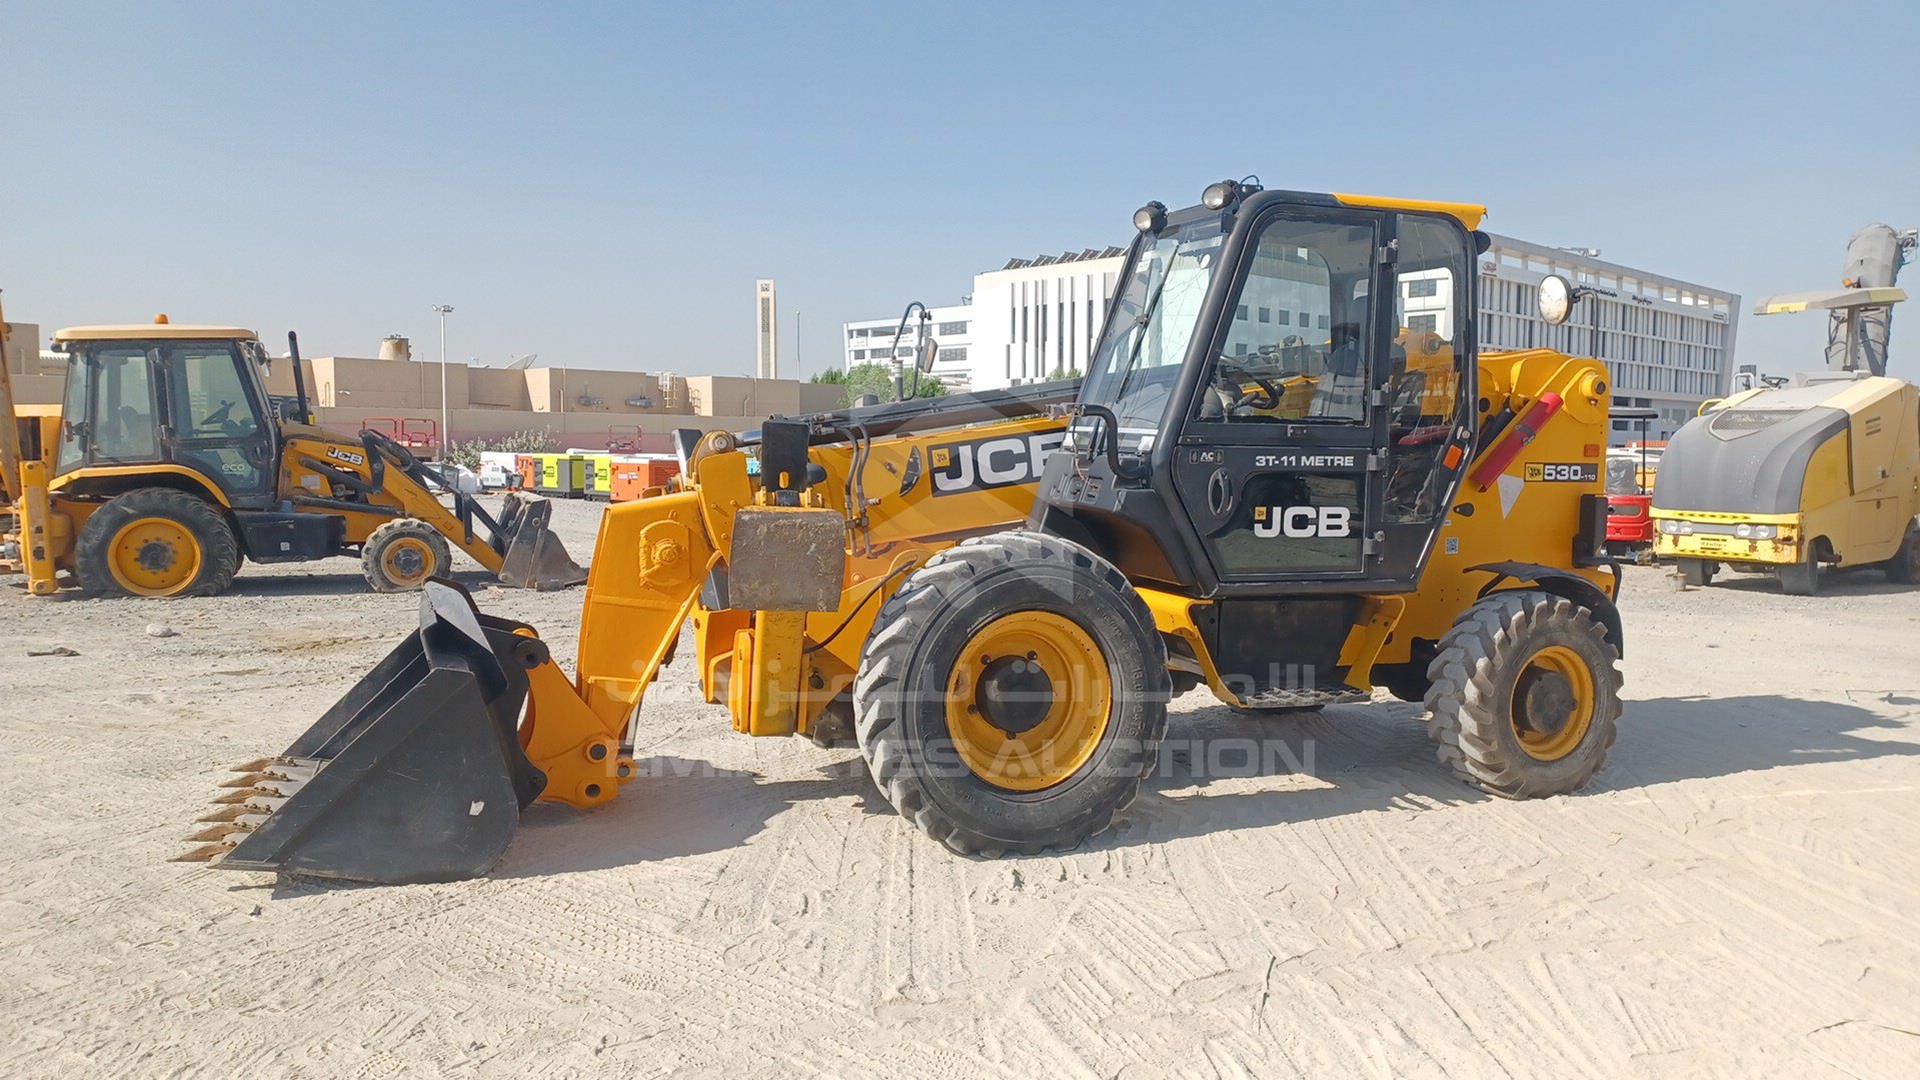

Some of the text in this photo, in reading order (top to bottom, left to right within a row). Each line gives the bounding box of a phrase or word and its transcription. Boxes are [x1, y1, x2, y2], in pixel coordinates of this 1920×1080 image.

[327, 446, 363, 465] JCB
[1200, 452, 1214, 461] AC
[1255, 455, 1355, 467] 3T-11 METRE
[221, 463, 246, 472] eco
[1253, 506, 1351, 538] JCB
